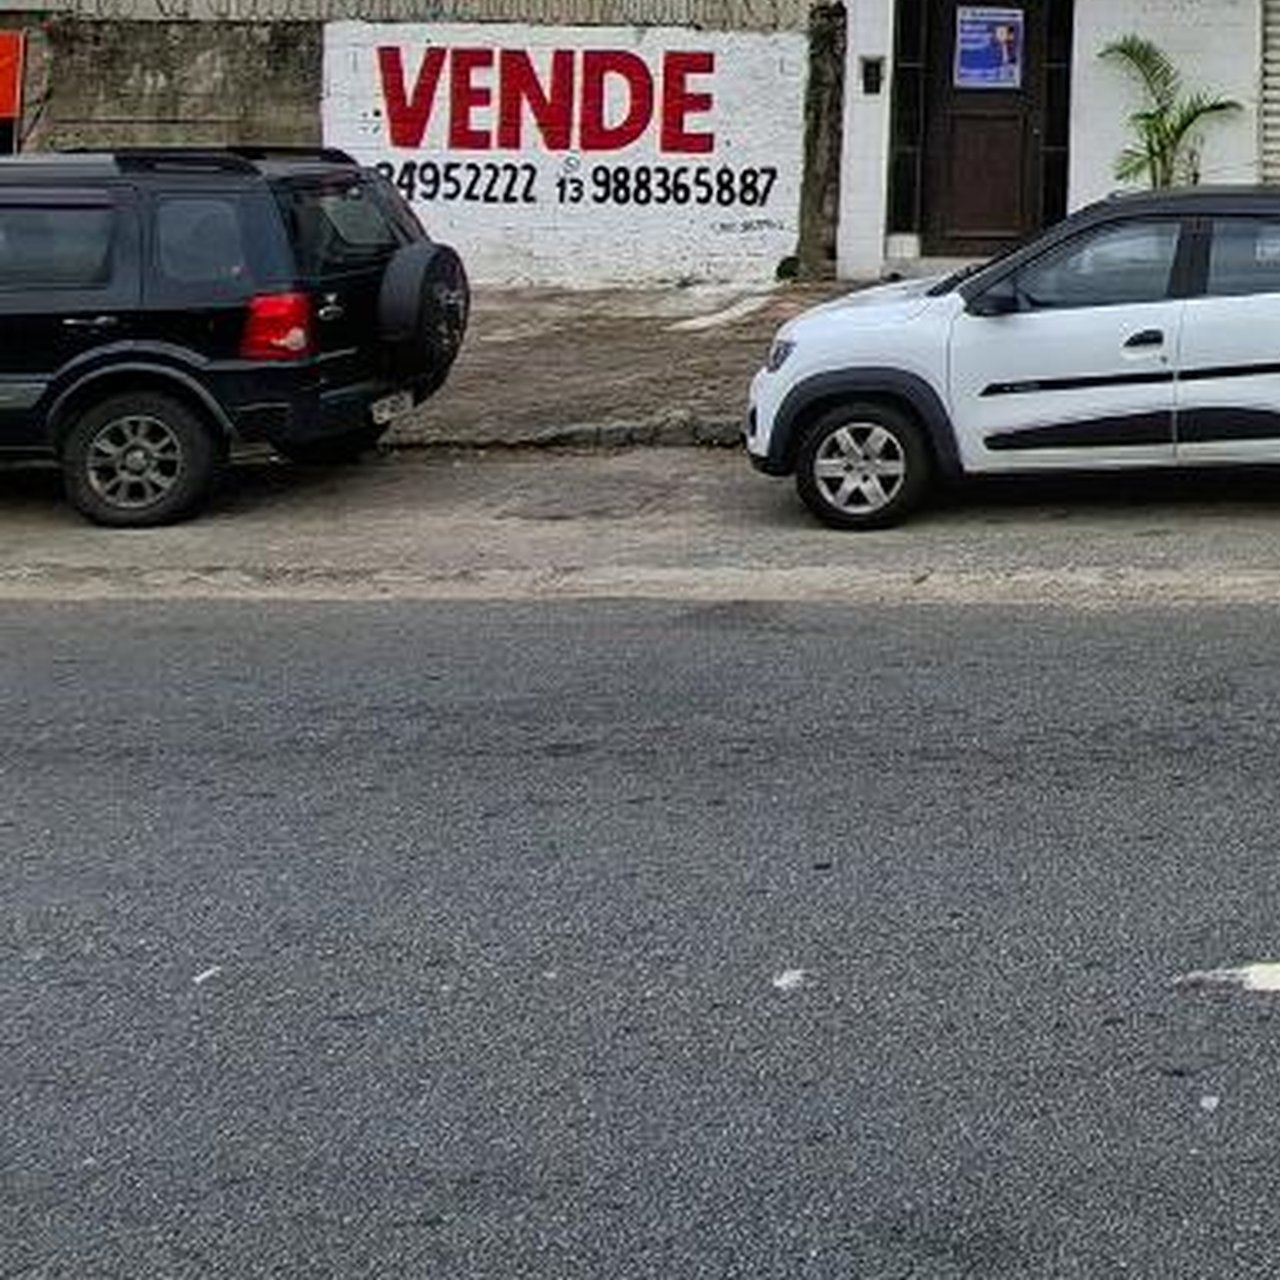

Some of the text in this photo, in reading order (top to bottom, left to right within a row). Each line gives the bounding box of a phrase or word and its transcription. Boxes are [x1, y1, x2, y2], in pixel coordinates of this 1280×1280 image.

[377, 46, 717, 153] VENDE
[555, 178, 585, 204] 13
[591, 166, 779, 207] 988365887
